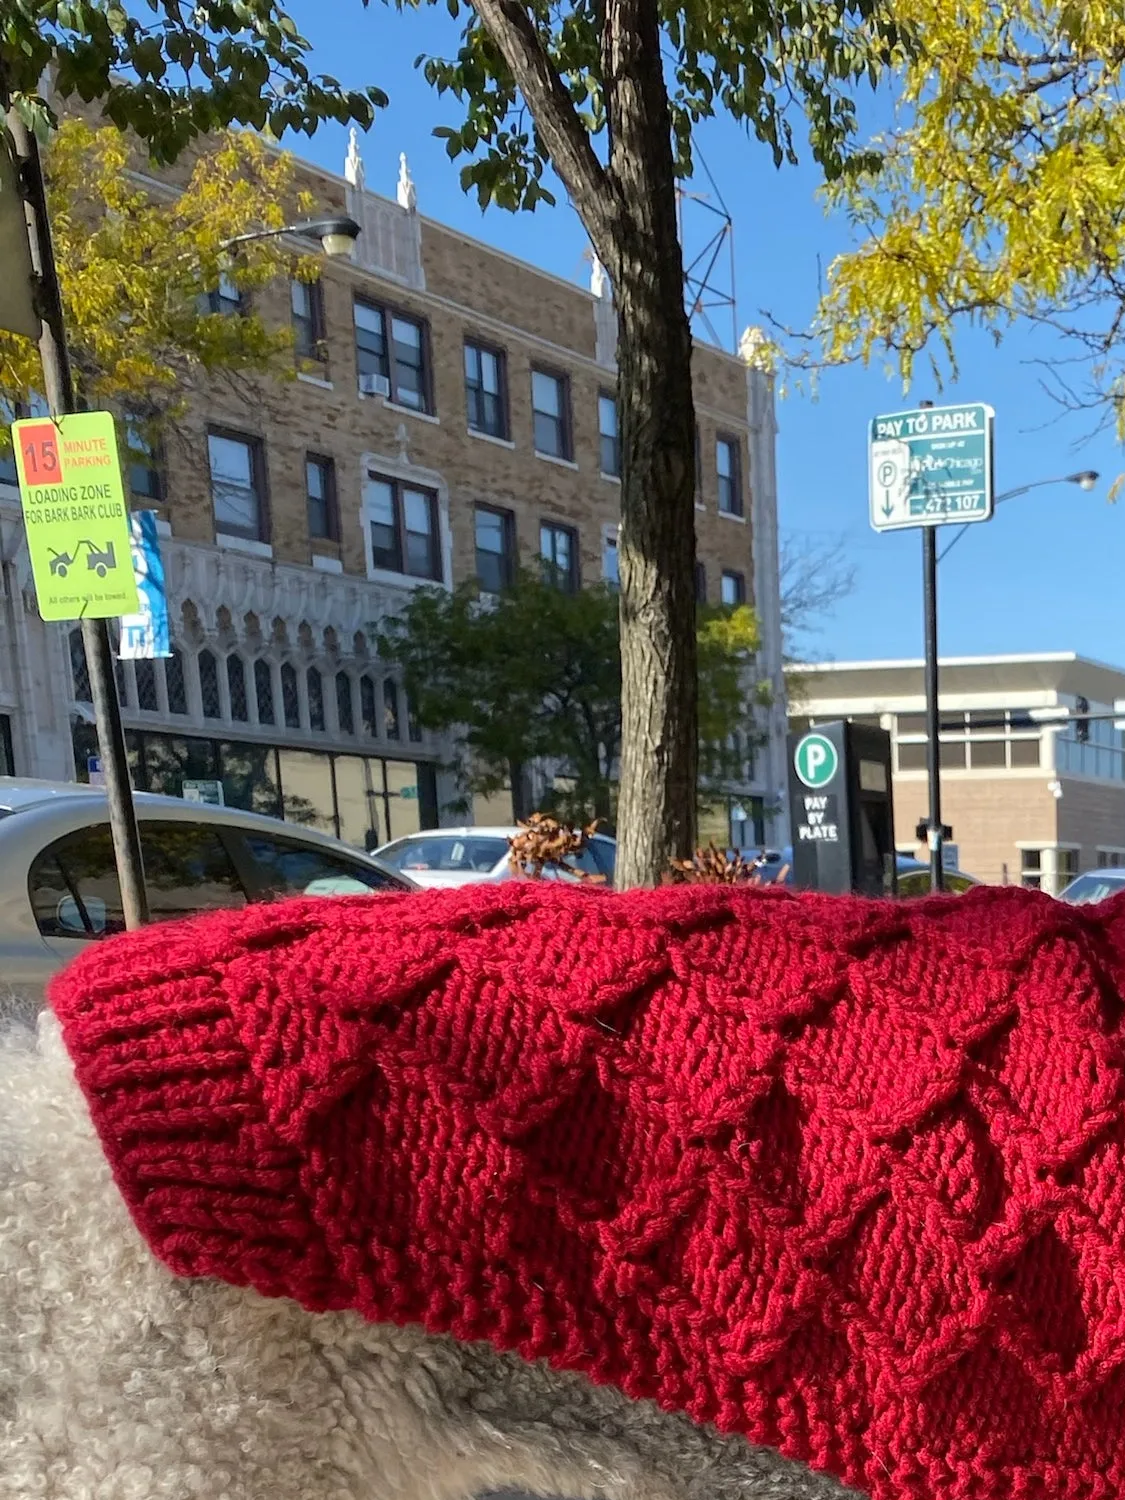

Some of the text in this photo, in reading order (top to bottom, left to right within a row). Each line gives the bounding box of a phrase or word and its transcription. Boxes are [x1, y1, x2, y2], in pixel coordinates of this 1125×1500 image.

[877, 412, 977, 436] PAY TO PARK
[63, 438, 107, 453] MINUTE
[24, 441, 57, 474] 15
[63, 454, 111, 467] PARKING
[28, 484, 112, 505] LOADING ZONE
[25, 502, 123, 525] FOR BARK BARK CLUB
[48, 596, 58, 605] All
[58, 595, 80, 604] others
[94, 593, 104, 602] be
[806, 743, 826, 780] P
[804, 797, 827, 811] PAY
[808, 812, 824, 825] BY
[798, 825, 838, 840] PLATE
